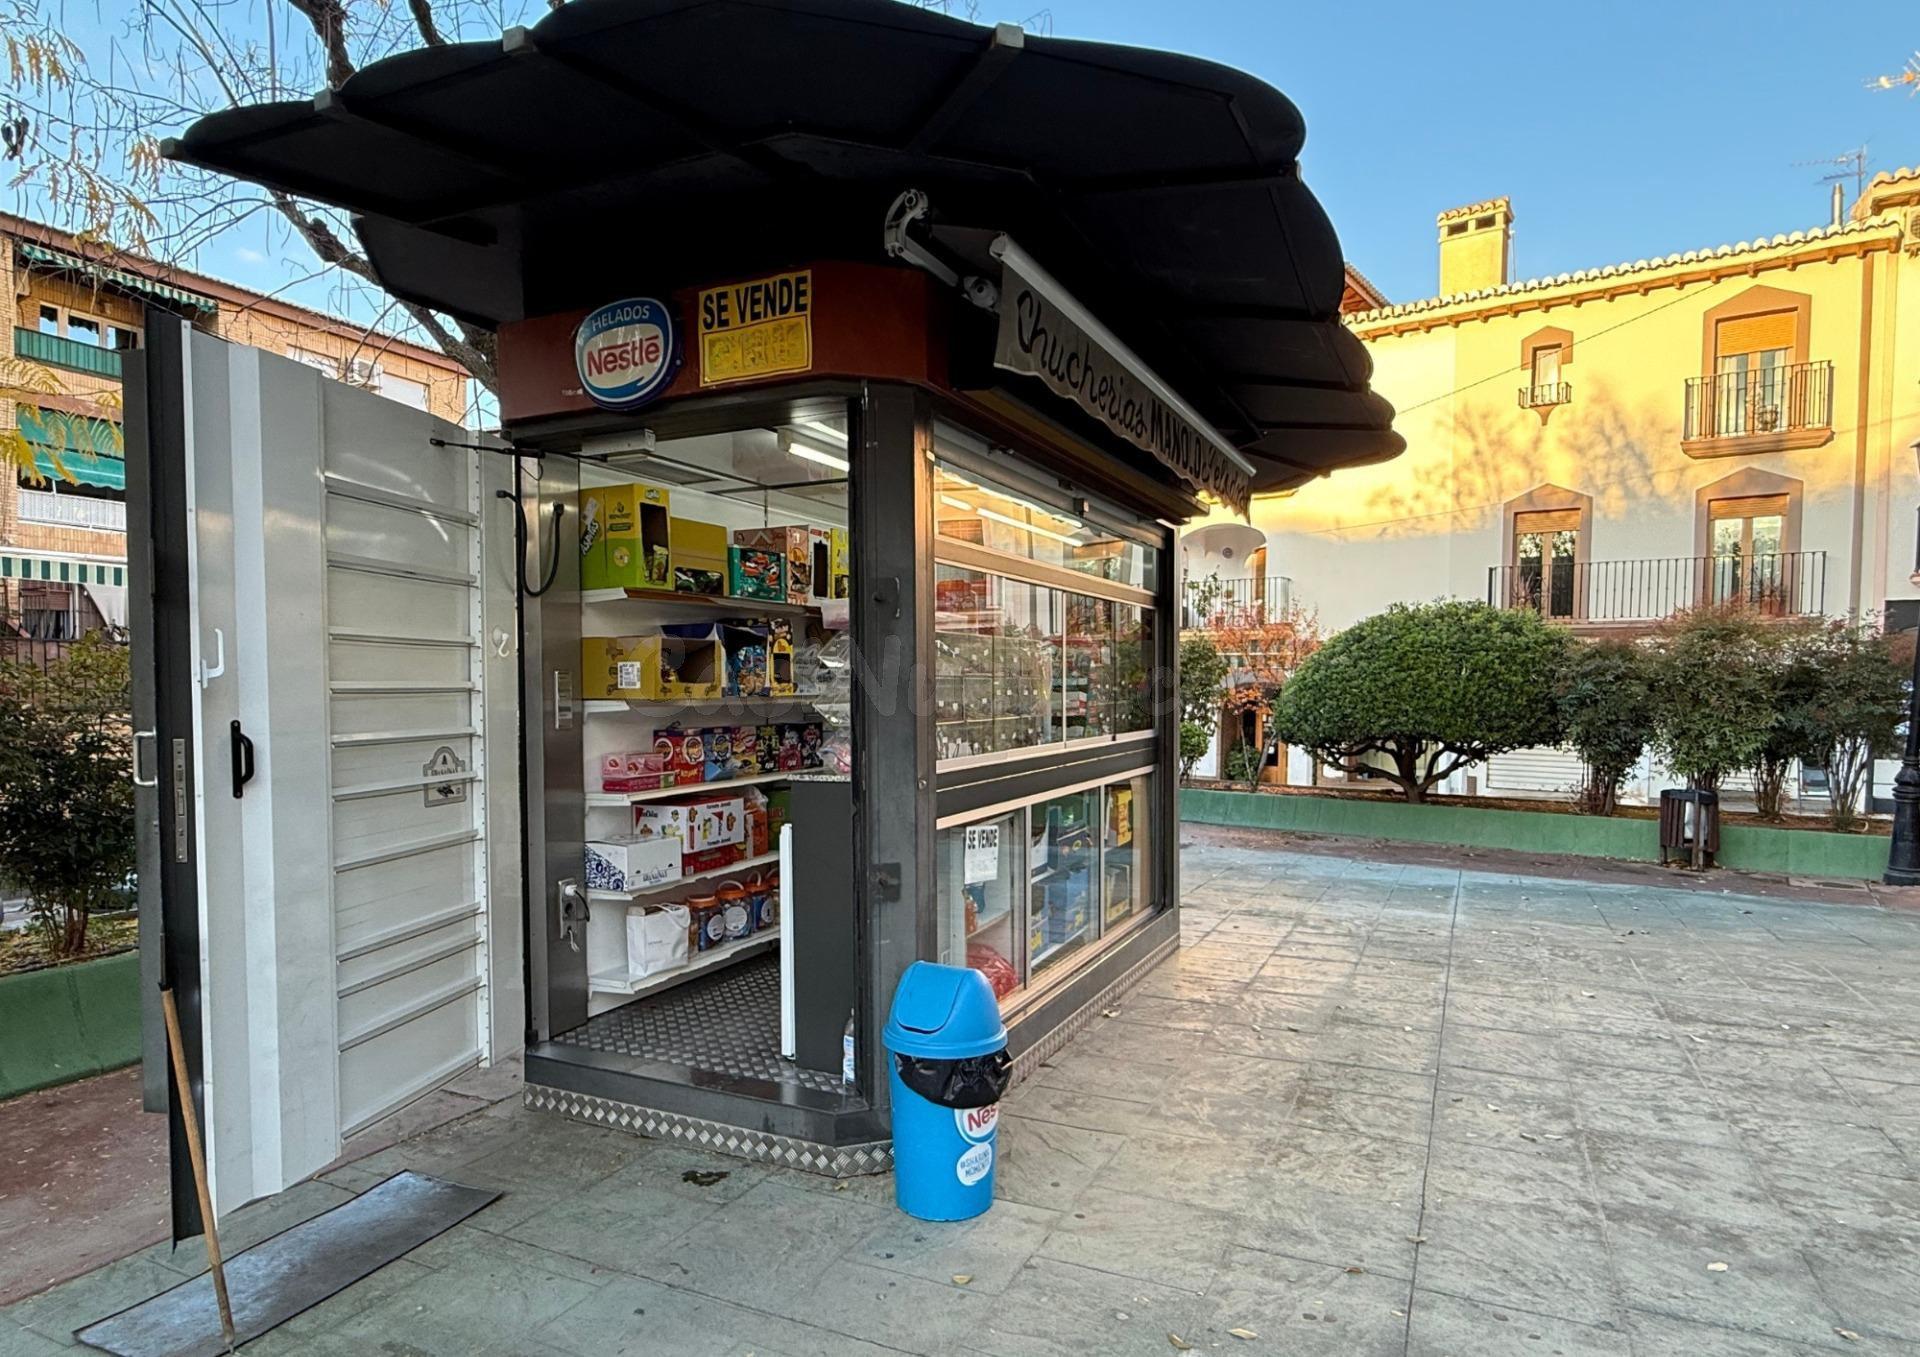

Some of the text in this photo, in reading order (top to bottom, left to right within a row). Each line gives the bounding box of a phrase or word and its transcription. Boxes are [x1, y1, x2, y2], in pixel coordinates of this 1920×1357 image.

[591, 305, 650, 332] HELADOS
[702, 276, 808, 330] SE VENDE
[586, 335, 660, 377] Nestlé
[968, 829, 998, 850] SE VENDE
